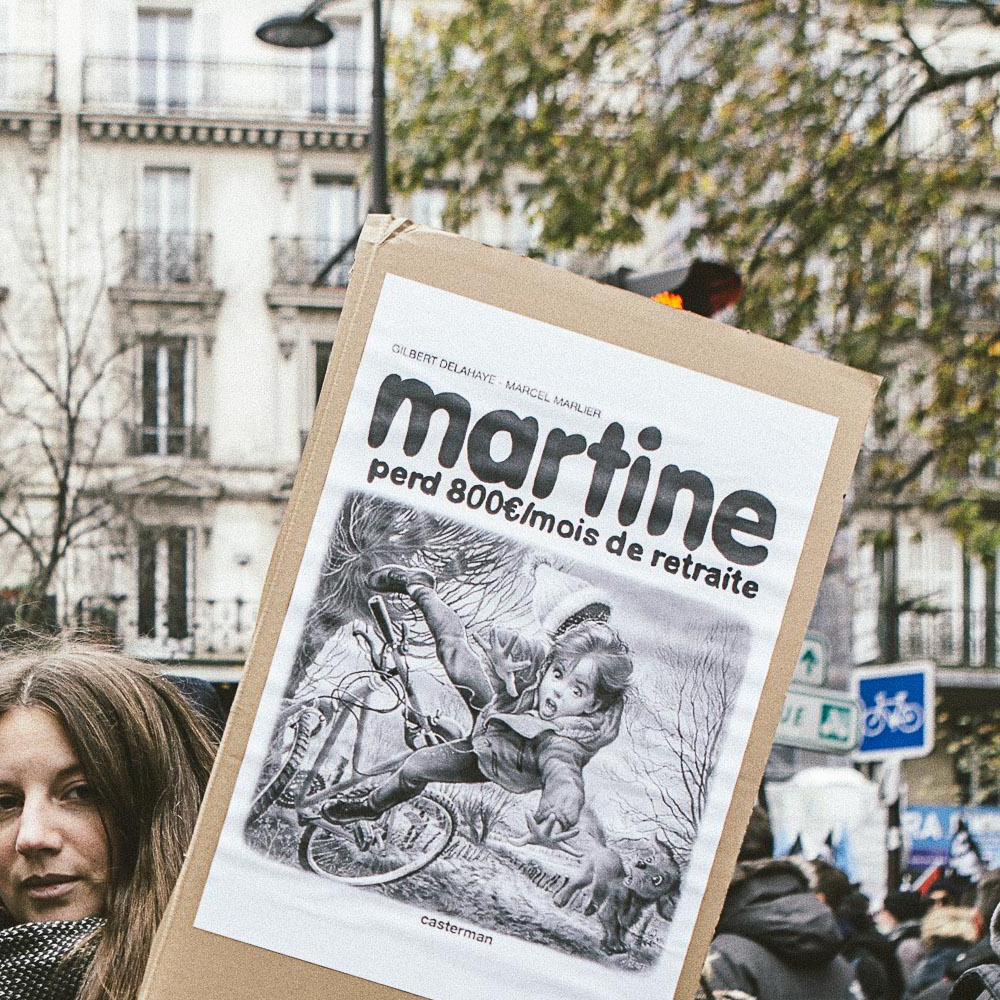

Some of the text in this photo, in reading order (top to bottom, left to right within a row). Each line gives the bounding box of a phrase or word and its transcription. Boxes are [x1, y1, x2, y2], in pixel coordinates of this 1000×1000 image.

[391, 343, 438, 366] GILBERT
[439, 357, 496, 385] DELAHAYE
[505, 379, 551, 403] MARCEL
[552, 395, 602, 419] MARLIER
[367, 373, 777, 566] martine
[367, 458, 759, 599] perd 800€/mois de retraite
[420, 915, 494, 945] casterman
